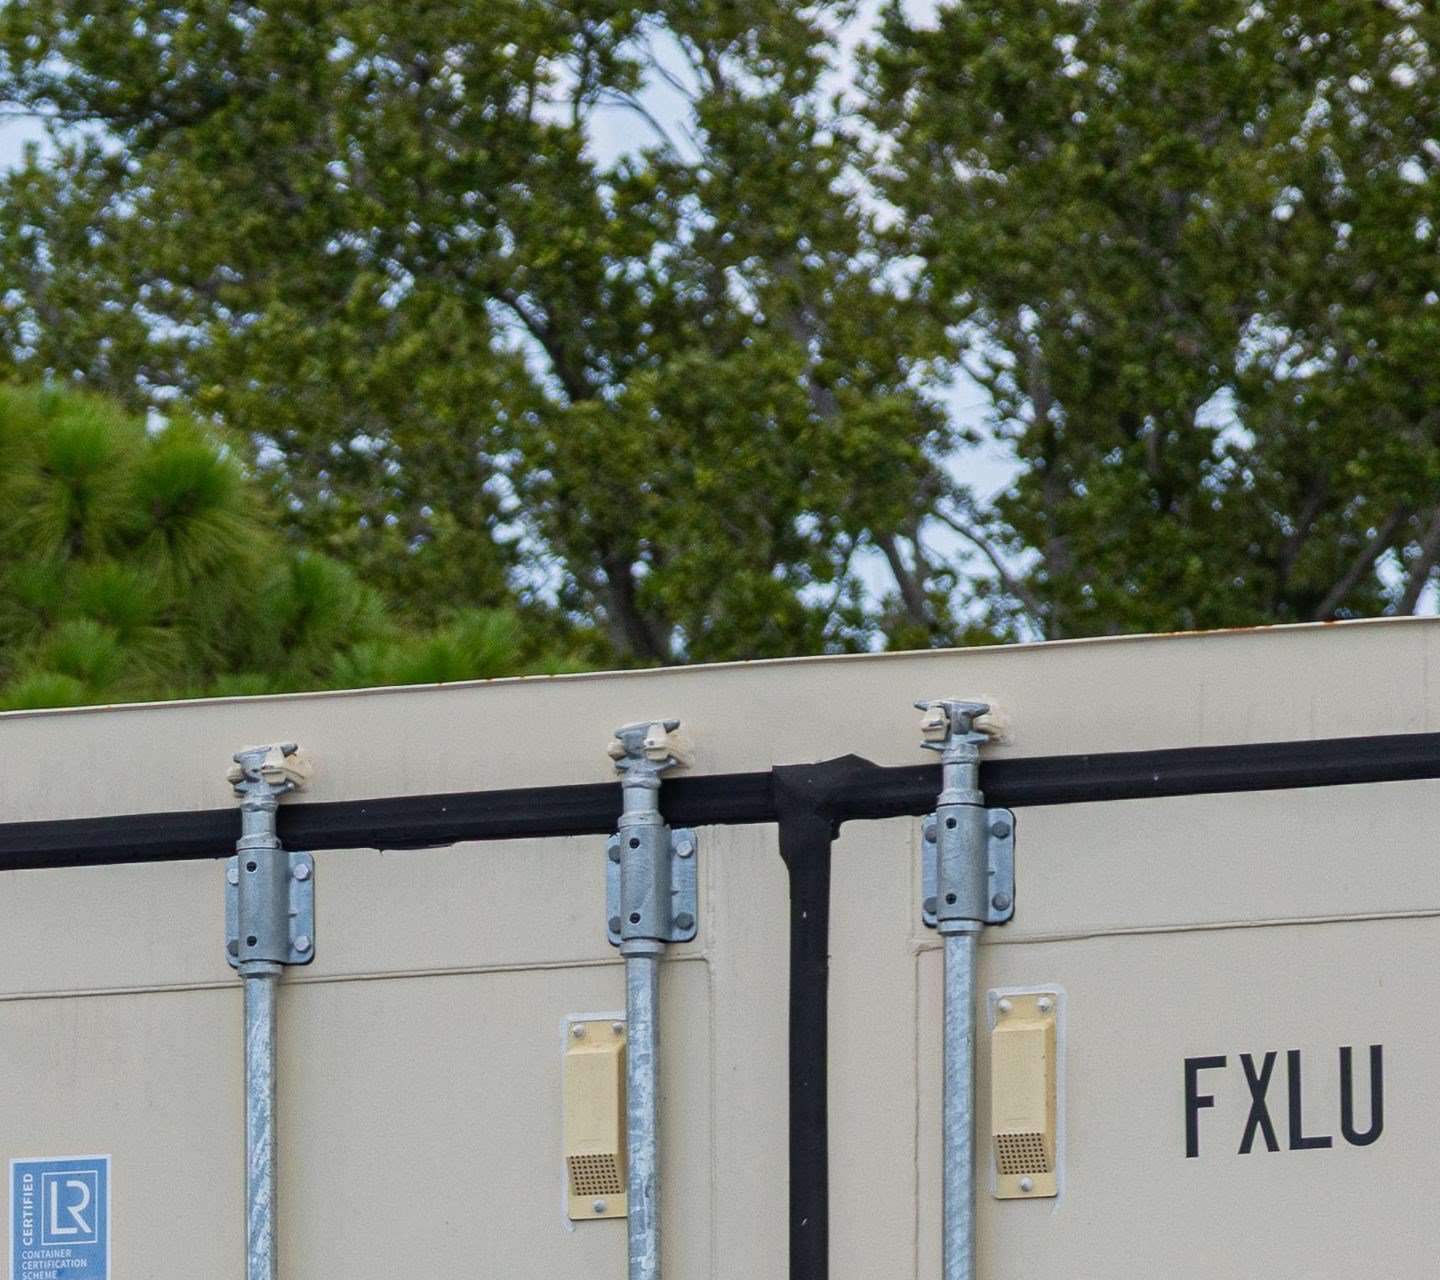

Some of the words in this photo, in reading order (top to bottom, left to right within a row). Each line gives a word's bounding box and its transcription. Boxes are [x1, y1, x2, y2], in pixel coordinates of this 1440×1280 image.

[1184, 1044, 1384, 1158] FXLU
[23, 1173, 33, 1246] CERTIFIED
[51, 1180, 92, 1235] LR
[22, 1249, 72, 1260] CONTAINER
[22, 1258, 87, 1270] CERTIFICATION
[22, 1270, 57, 1280] SCHEME
